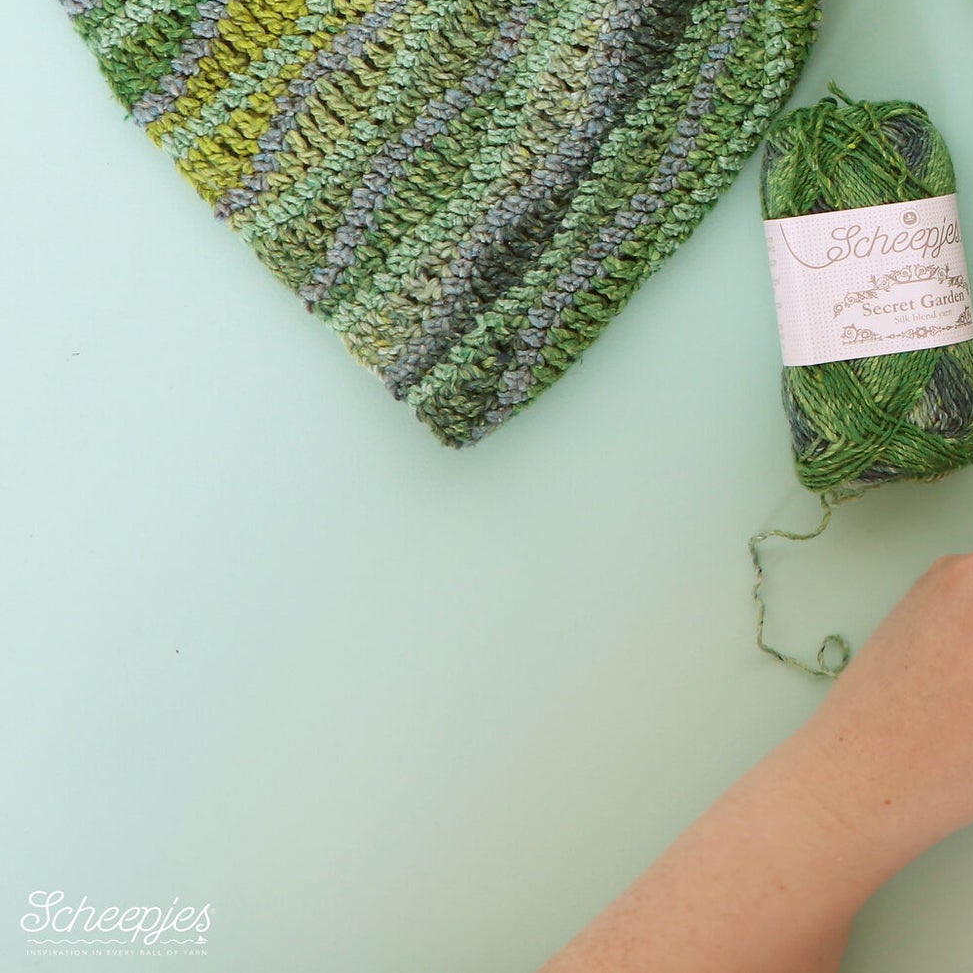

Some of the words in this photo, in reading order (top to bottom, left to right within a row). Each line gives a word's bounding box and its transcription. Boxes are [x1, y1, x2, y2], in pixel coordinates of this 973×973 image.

[826, 216, 961, 261] Scheepjes
[862, 300, 915, 317] Secret
[920, 290, 965, 308] Garden
[894, 314, 909, 324] Silk
[912, 311, 937, 322] blend
